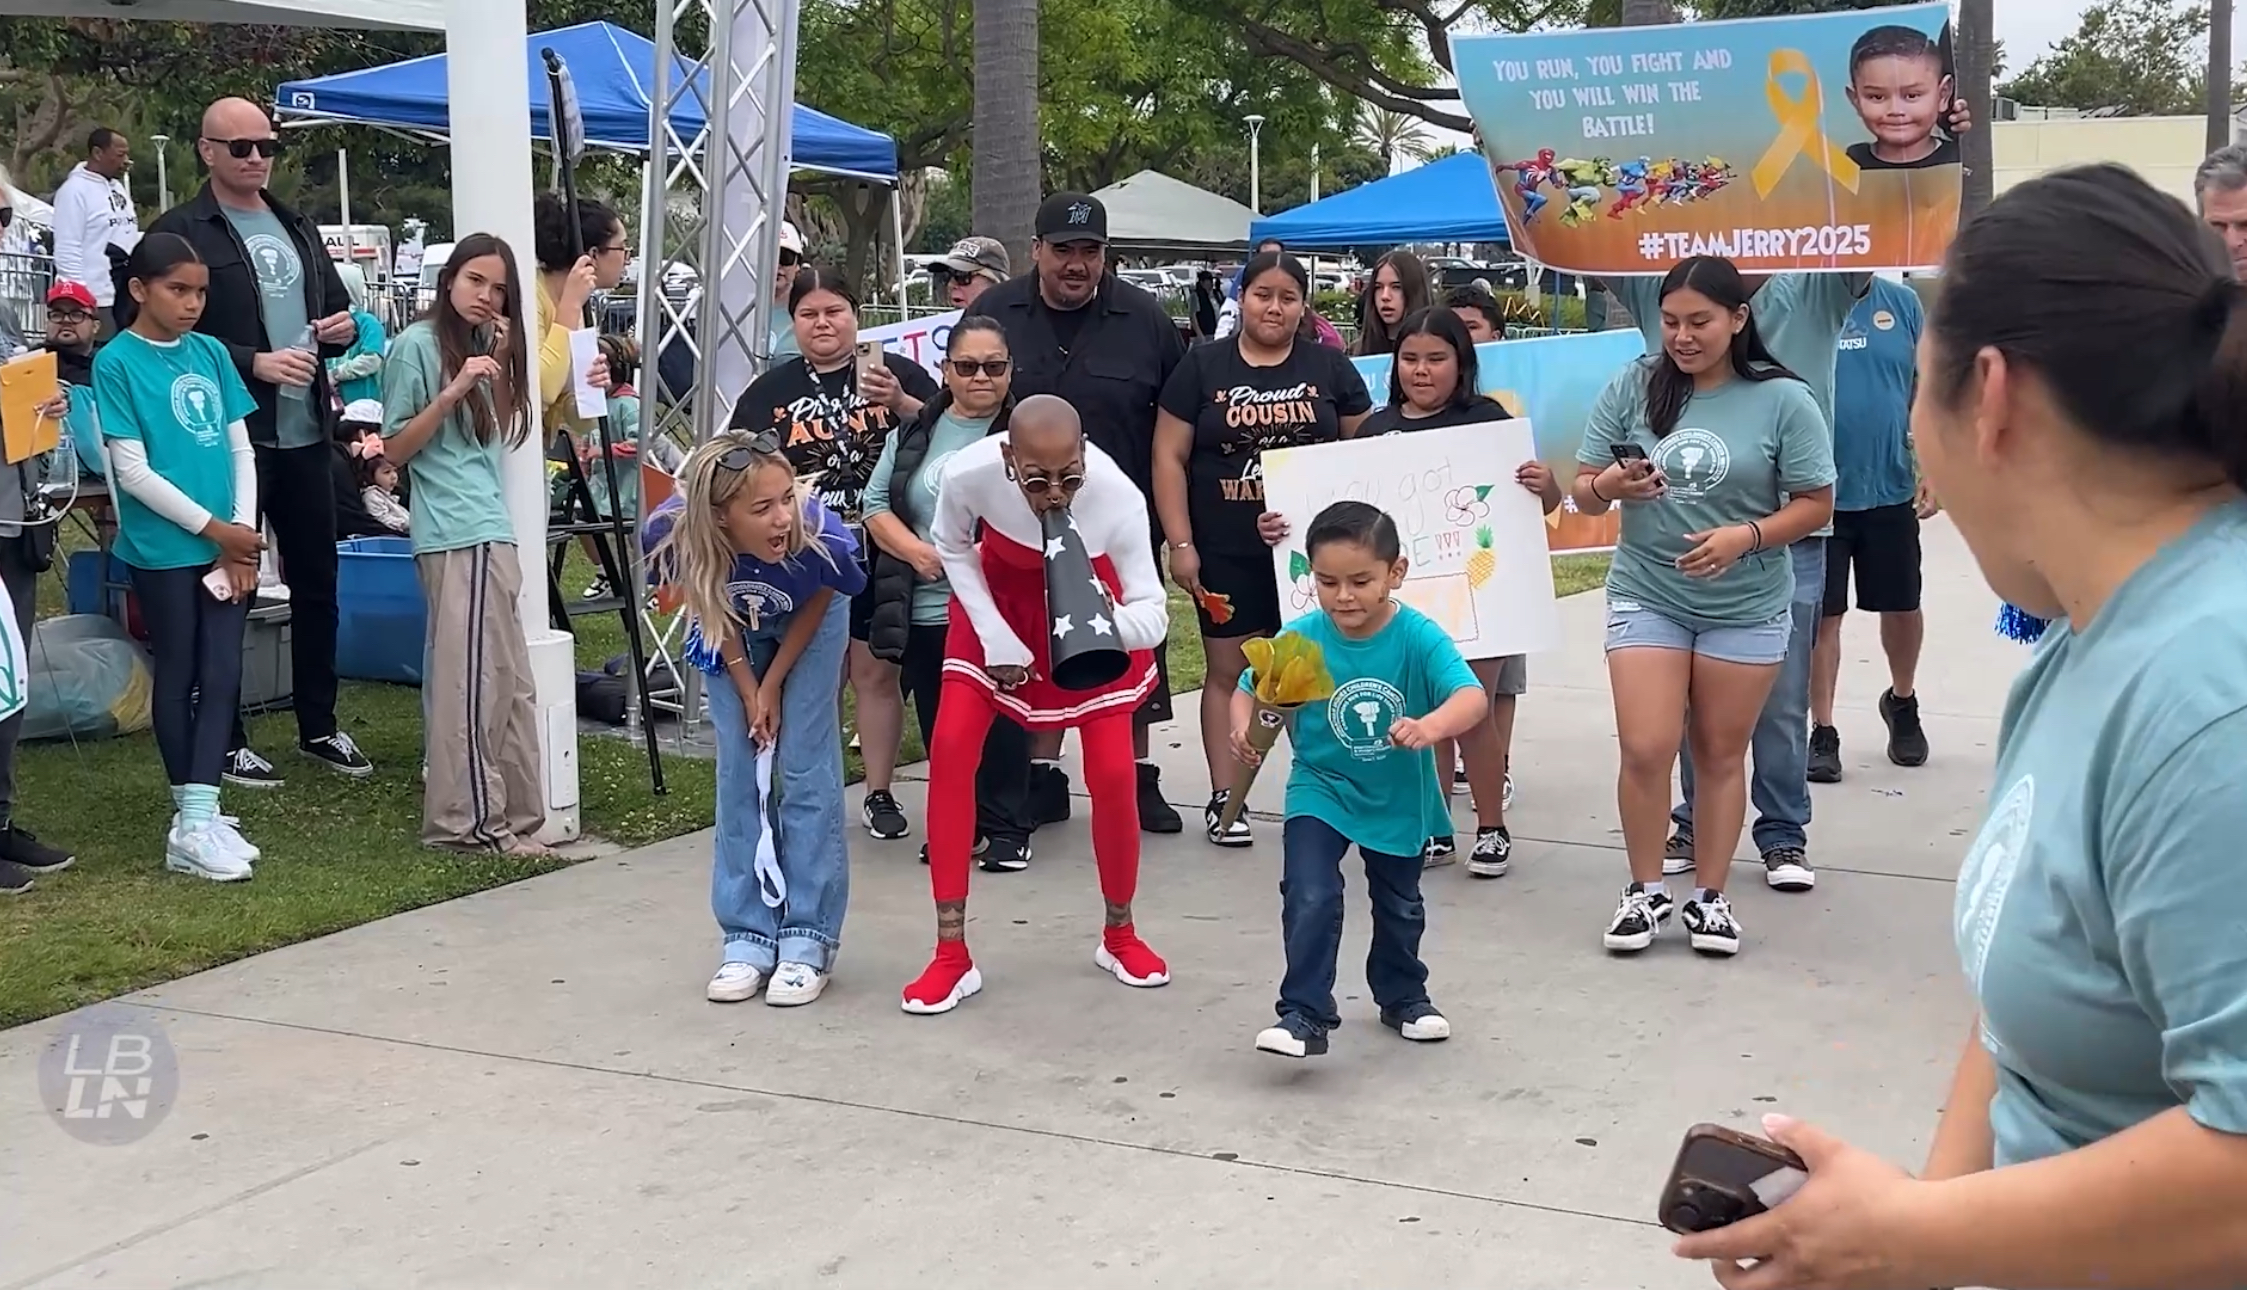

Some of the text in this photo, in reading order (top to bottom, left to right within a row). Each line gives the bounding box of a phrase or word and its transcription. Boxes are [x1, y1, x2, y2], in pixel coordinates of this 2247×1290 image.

[1493, 48, 1733, 82] YOU RUN, YOU FIGHT AND
[1528, 80, 1702, 110] YOU WILL WIN THE
[1582, 112, 1655, 138] BATTLE!
[1638, 224, 1871, 259] #TEAMJERRY2025
[787, 393, 871, 423] Prou
[1228, 382, 1307, 406] Proud
[1225, 401, 1317, 428] COUSIN
